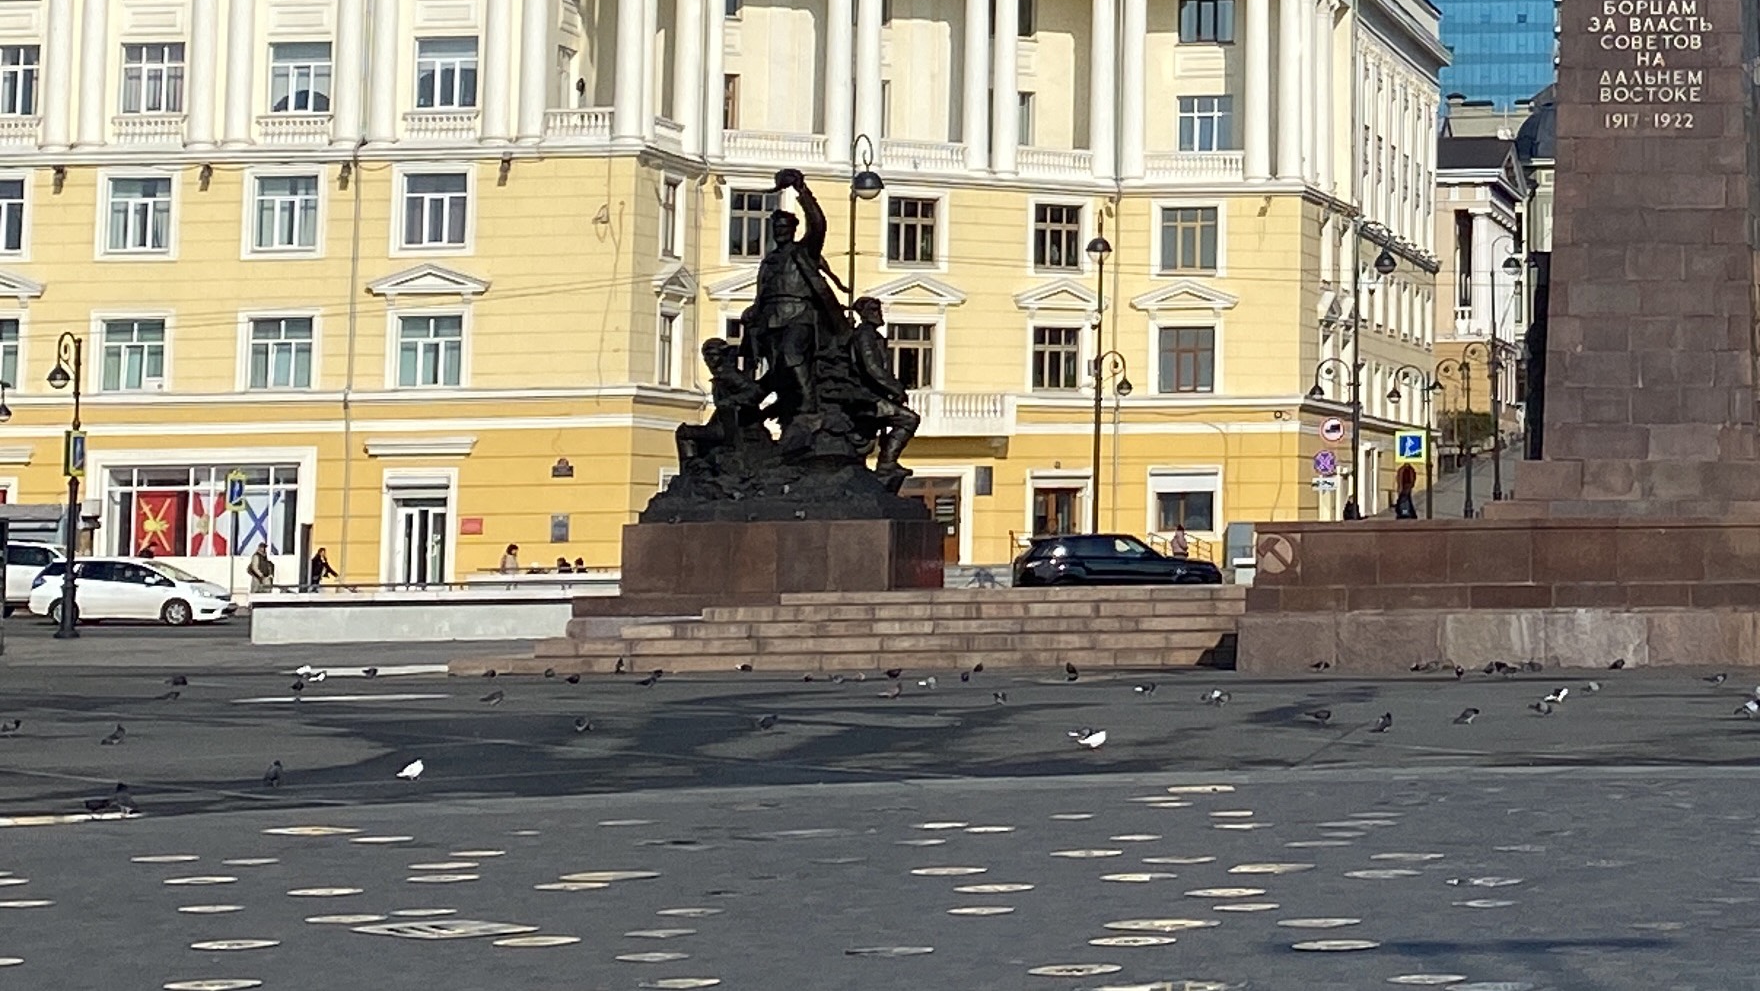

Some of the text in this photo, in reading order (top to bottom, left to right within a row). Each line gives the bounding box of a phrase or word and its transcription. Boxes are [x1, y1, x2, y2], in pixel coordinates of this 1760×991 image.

[1603, 0, 1697, 15] БОРЦАМ
[1588, 16, 1713, 33] ЗА ВЛАСТЬ
[1600, 34, 1702, 50] СОВЕТОВ
[1637, 51, 1666, 67] НА
[1599, 69, 1703, 86] ДАЛЬНЕМ
[1600, 86, 1701, 103] ВОСТОКЕ
